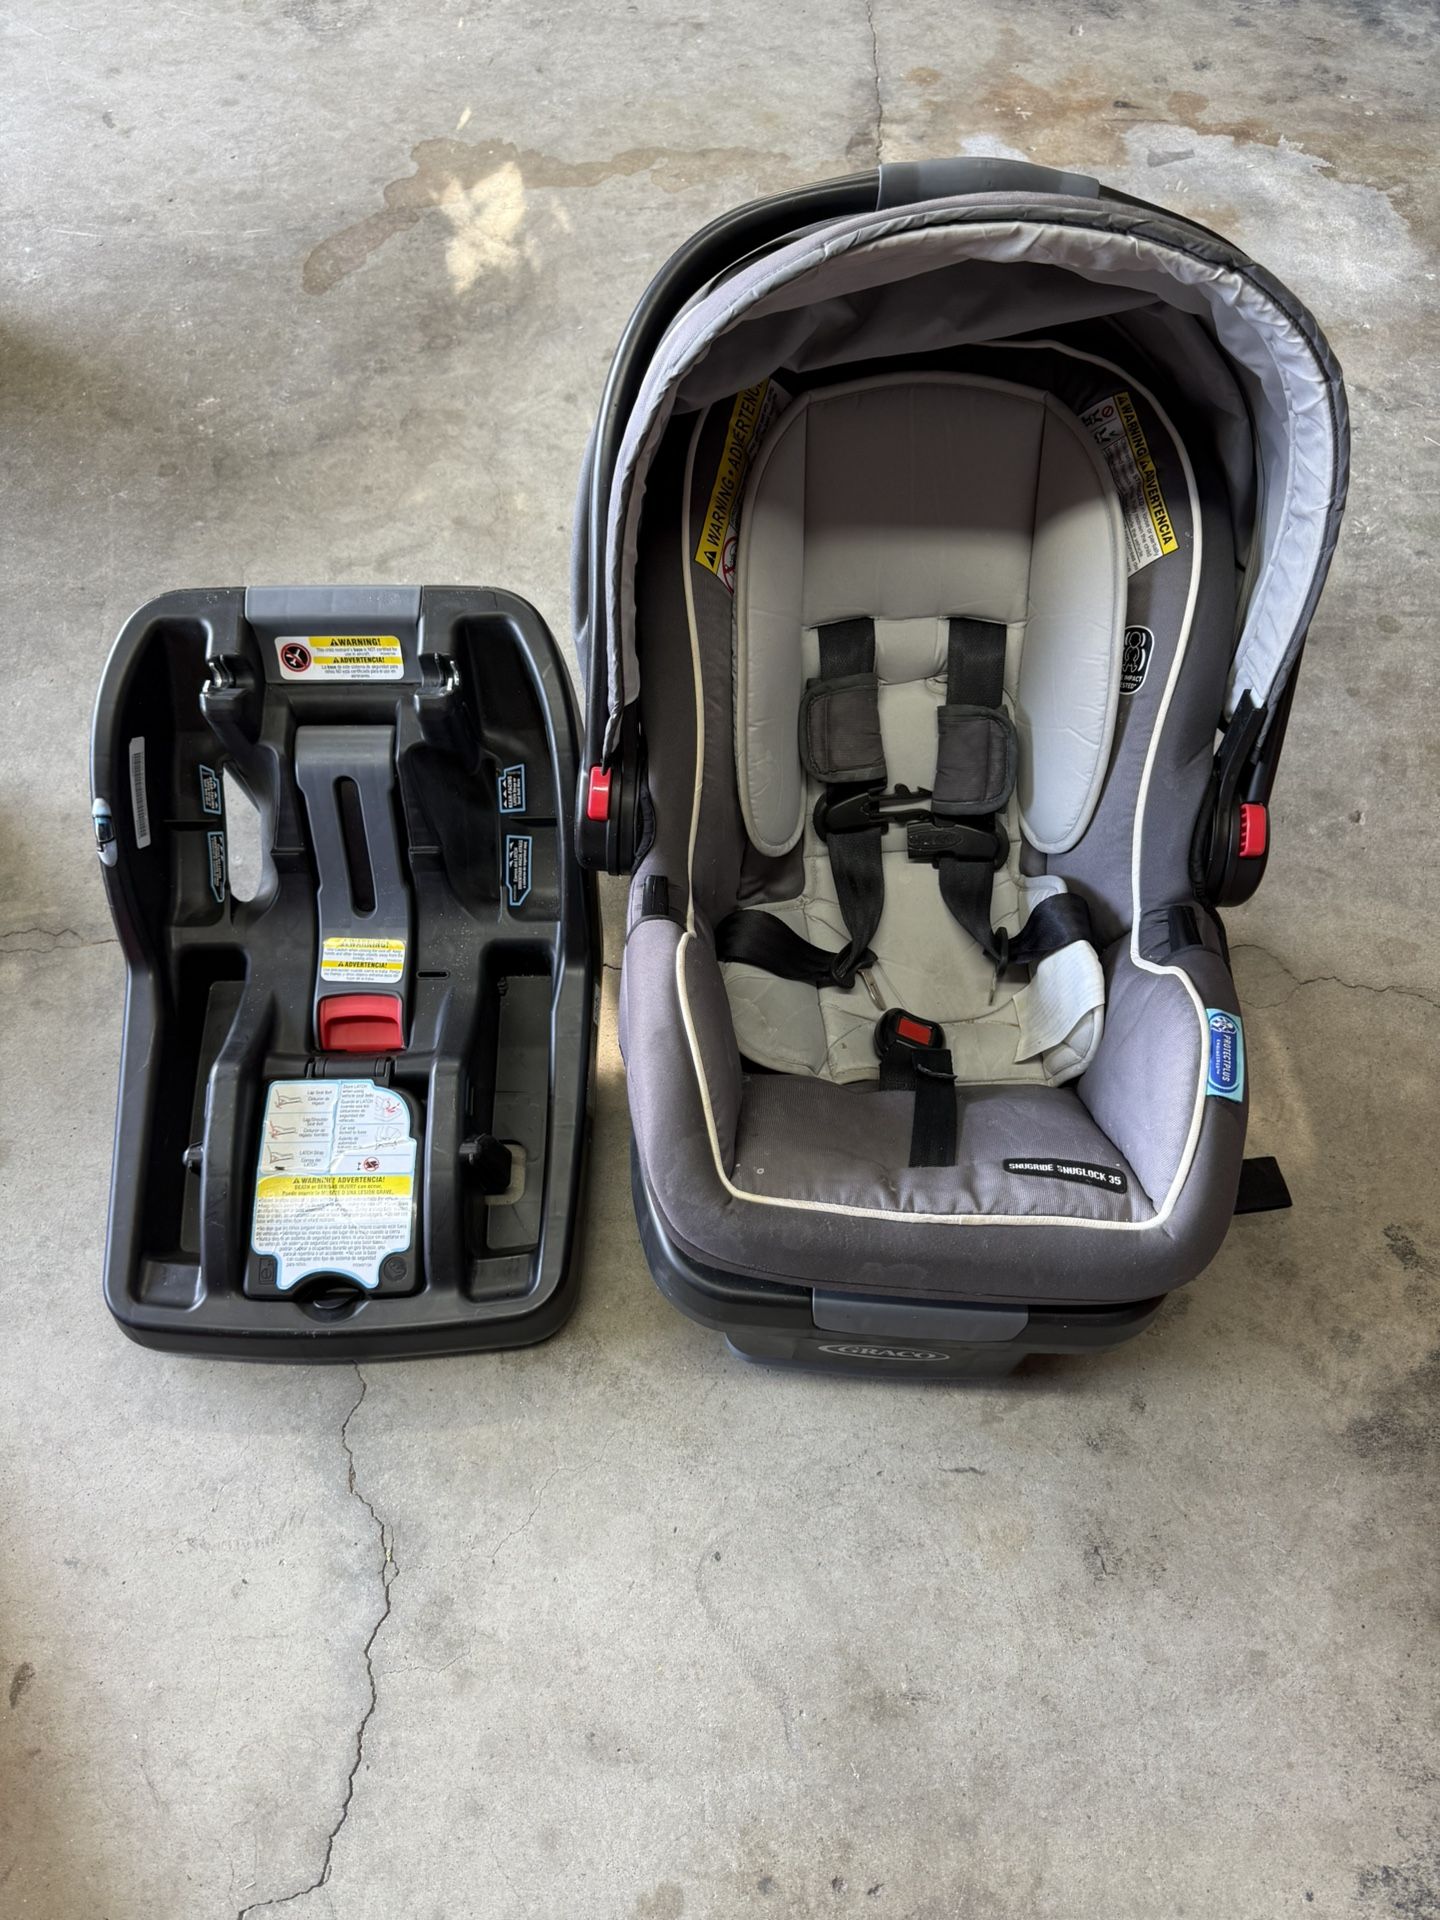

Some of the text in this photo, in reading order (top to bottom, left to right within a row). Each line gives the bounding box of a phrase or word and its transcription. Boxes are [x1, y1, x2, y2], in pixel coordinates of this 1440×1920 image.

[707, 478, 734, 546] WARNING
[338, 638, 381, 646] WARNING!
[1222, 1034, 1232, 1082] PROTECTPLUS
[1008, 1163, 1122, 1185] SNUGRIDE SNUGLOCK 35
[838, 1346, 936, 1359] GRACO
